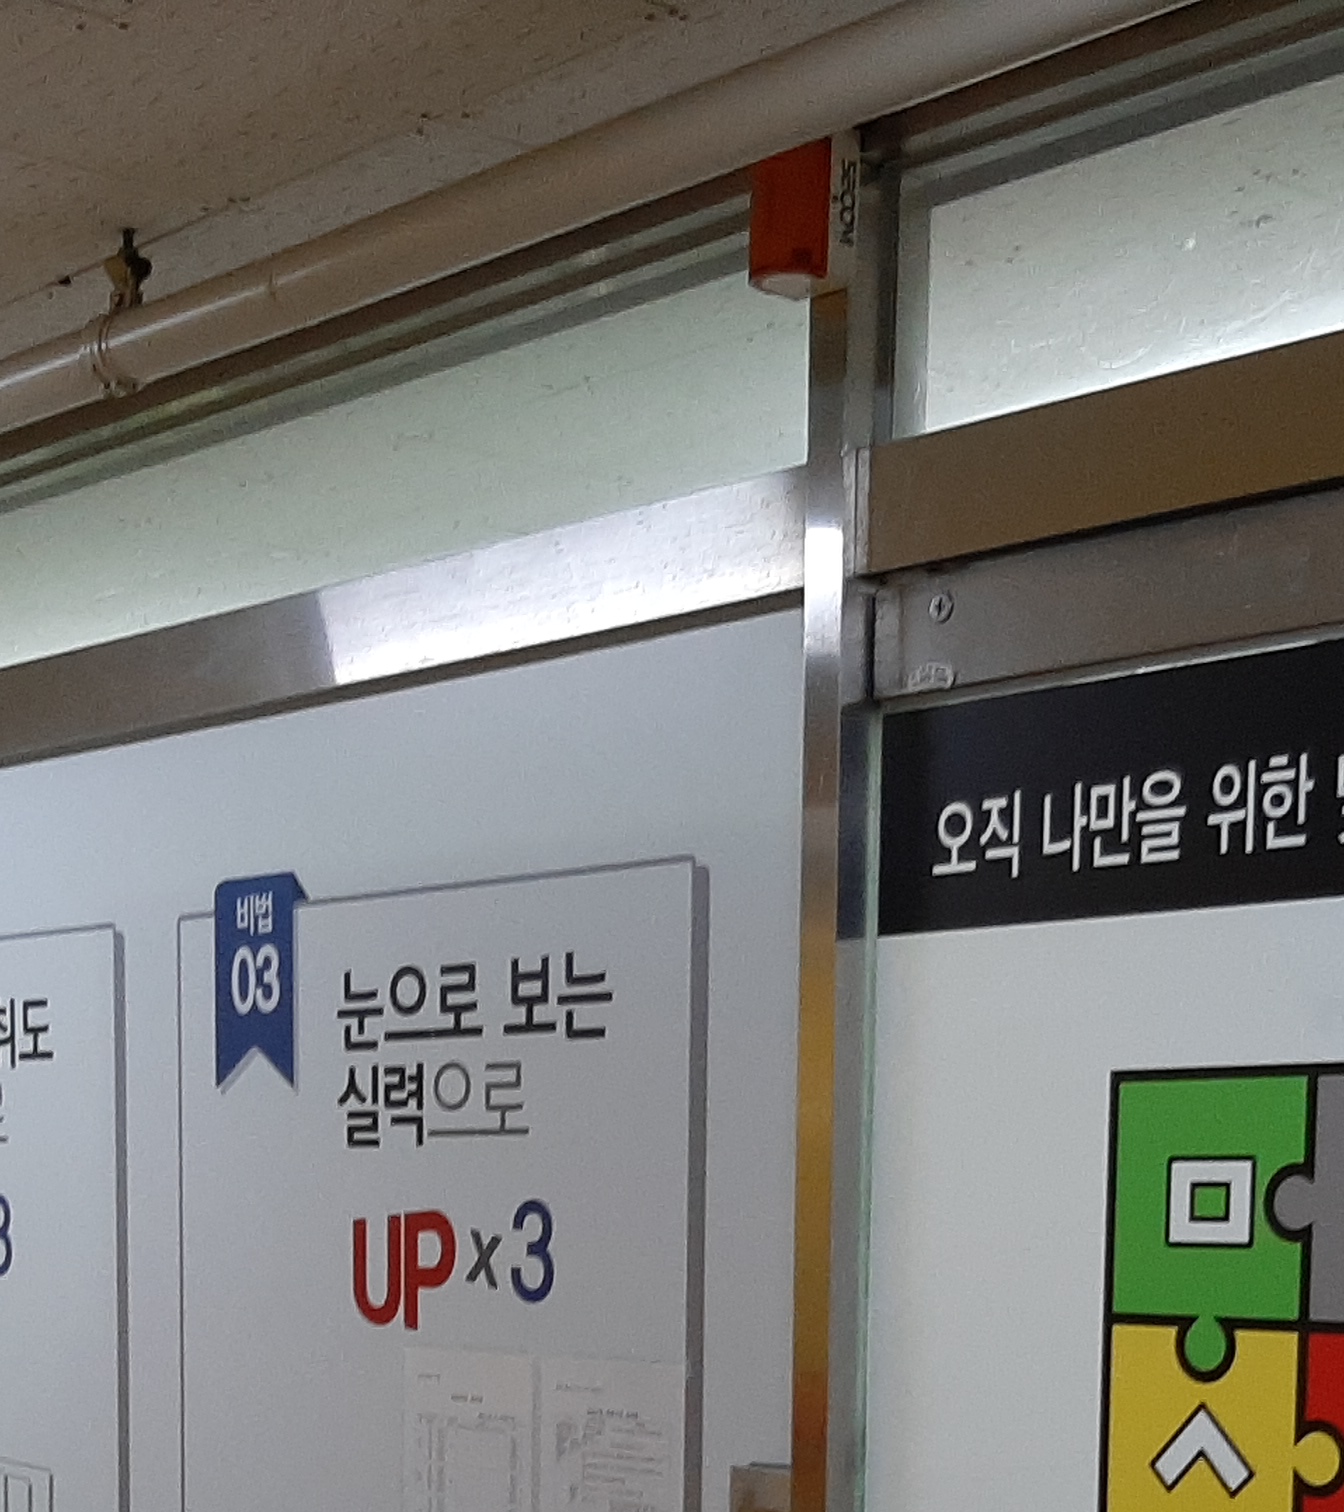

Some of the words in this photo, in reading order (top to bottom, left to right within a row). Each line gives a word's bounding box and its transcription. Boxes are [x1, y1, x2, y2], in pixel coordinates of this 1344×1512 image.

[932, 789, 1023, 880] 오직
[1041, 769, 1187, 874] 나만을
[1206, 751, 1316, 856] 위한
[236, 890, 274, 937] 비법
[231, 943, 281, 1016] 03
[336, 964, 483, 1052] 눈으로
[503, 950, 613, 1040] 보는
[336, 1059, 530, 1149] 실력으로
